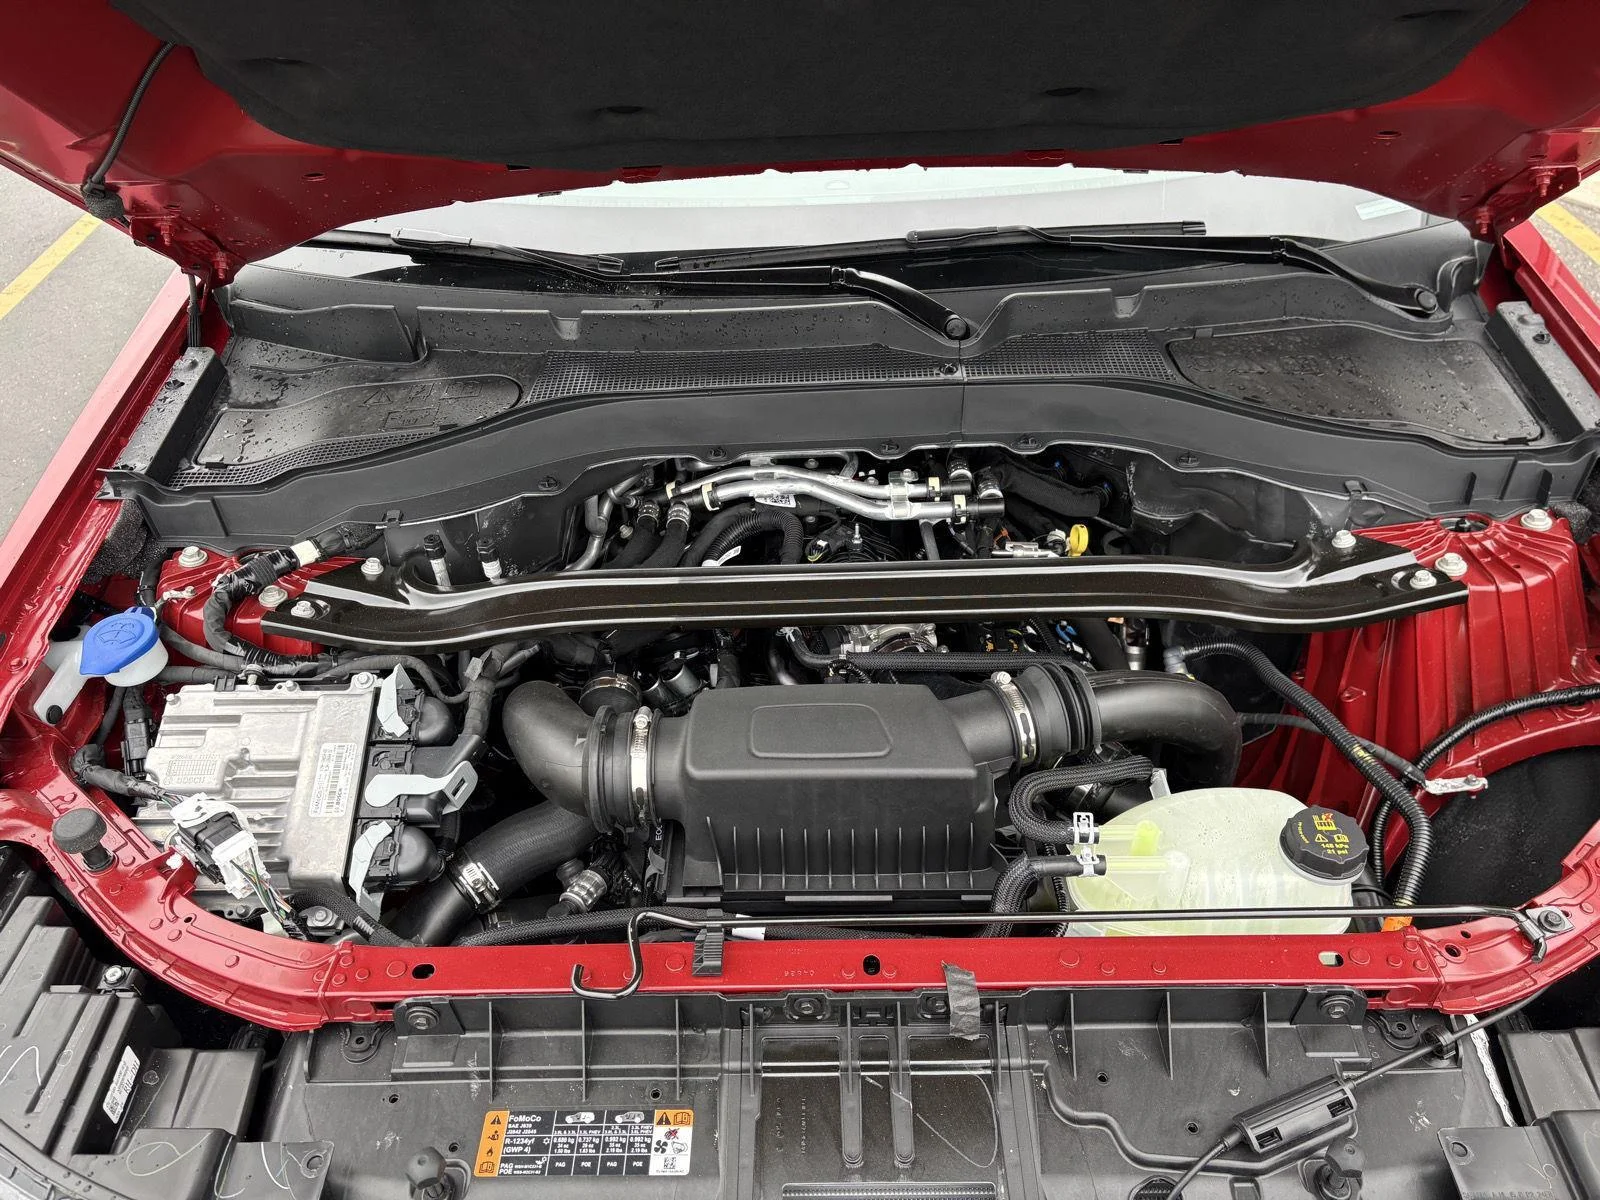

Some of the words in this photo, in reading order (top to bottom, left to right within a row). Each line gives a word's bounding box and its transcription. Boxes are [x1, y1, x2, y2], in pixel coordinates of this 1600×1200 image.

[508, 1114, 542, 1122] FoMoCo
[503, 1146, 523, 1154] (GWP
[524, 1146, 531, 1154] 4)
